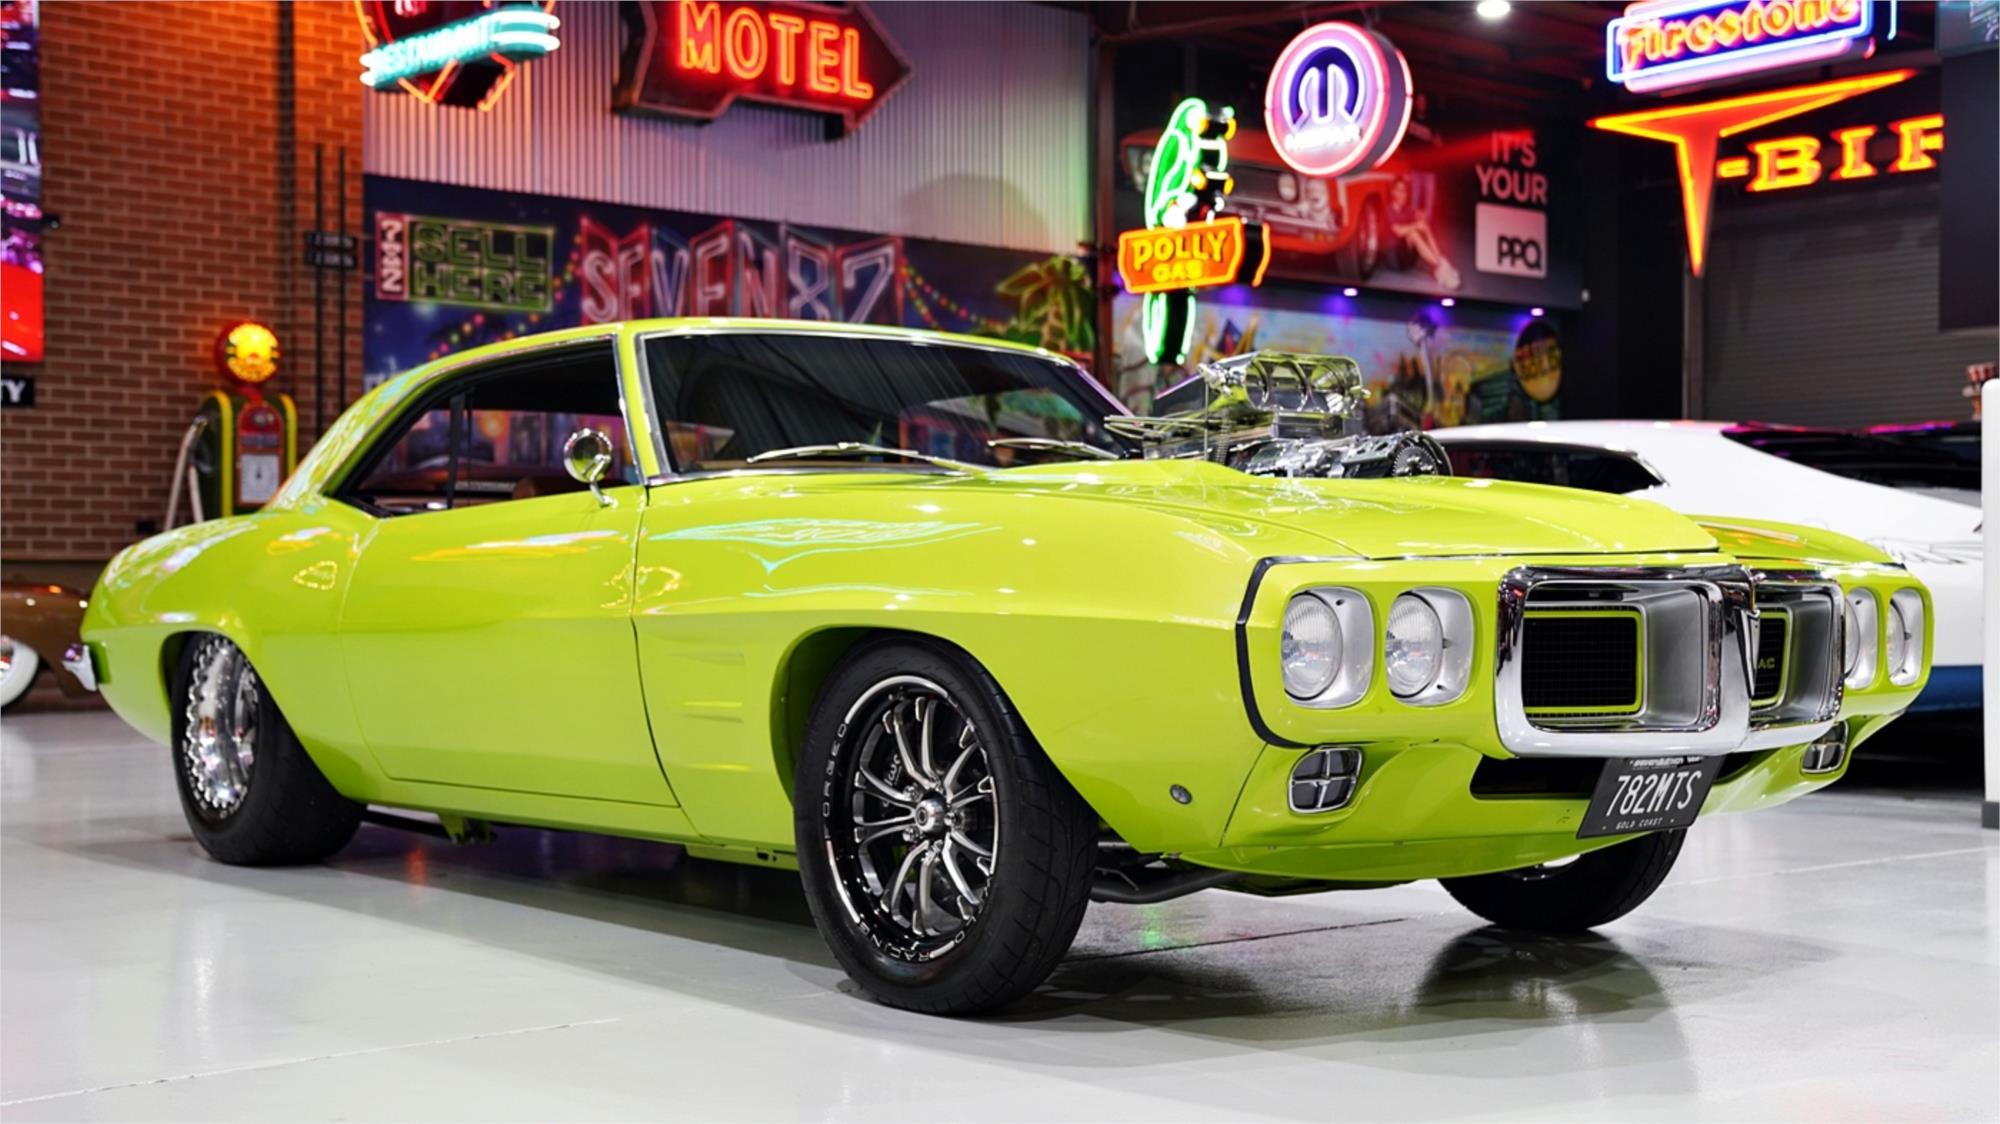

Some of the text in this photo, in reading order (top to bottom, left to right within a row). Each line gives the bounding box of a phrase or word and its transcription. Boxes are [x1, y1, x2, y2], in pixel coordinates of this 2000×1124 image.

[680, 0, 874, 100] MOTEL
[1622, 0, 1861, 69] Firestone
[1491, 131, 1536, 168] IT'S
[1475, 162, 1548, 205] YOUR
[413, 223, 547, 269] SELL
[1132, 230, 1227, 271] POLLY
[1497, 234, 1542, 271] PPQ
[413, 260, 547, 308] HERE
[1152, 258, 1203, 283] GAS
[822, 723, 848, 839] FORGED
[1605, 770, 1702, 816] 782MTS
[1615, 817, 1663, 830] GOLD COAST
